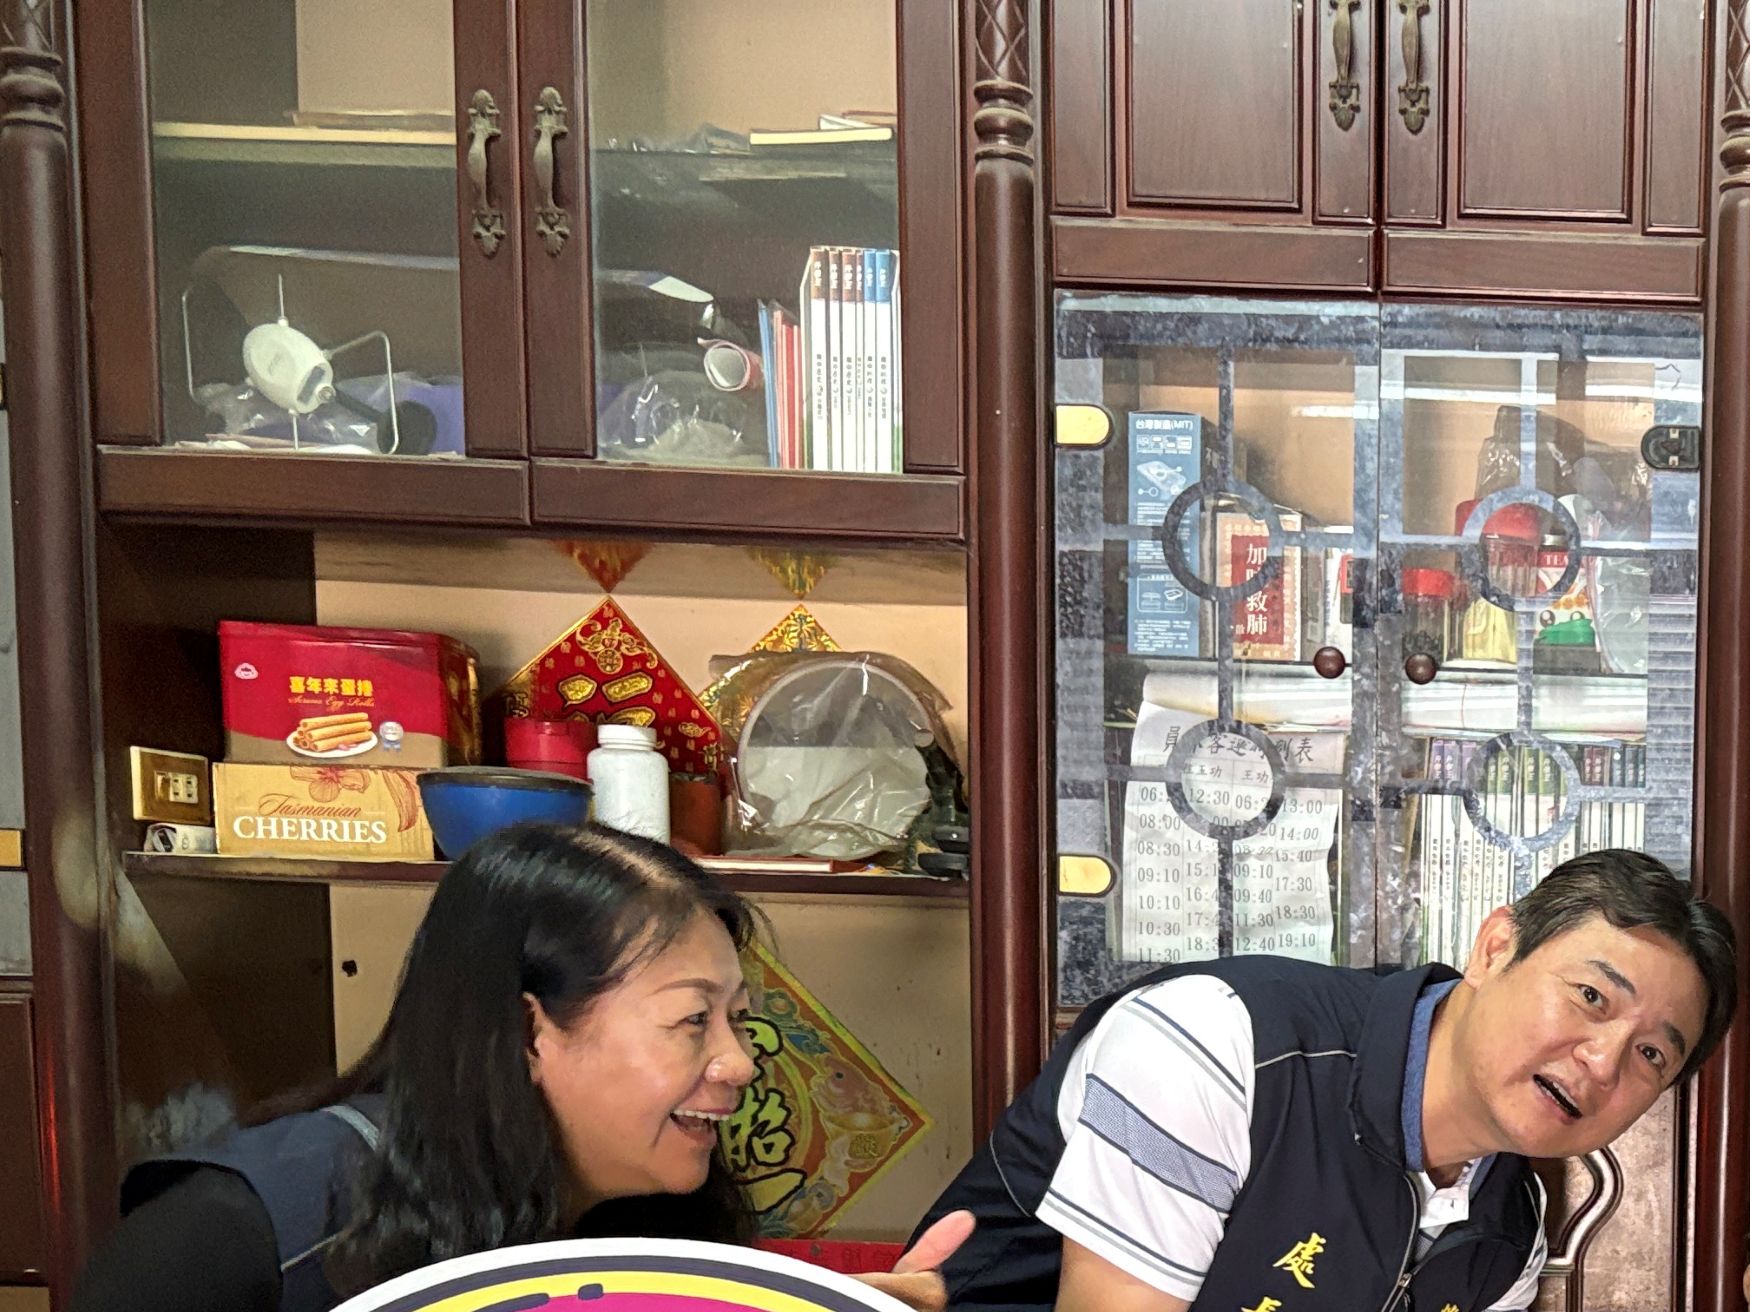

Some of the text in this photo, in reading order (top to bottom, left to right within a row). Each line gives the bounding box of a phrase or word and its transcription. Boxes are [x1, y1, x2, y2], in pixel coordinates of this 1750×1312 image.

[258, 793, 362, 818] Tasmanian
[1190, 788, 1230, 805] 12:30
[1283, 800, 1322, 814] 13:00
[233, 815, 387, 844] CHERRIES
[1139, 814, 1319, 841] 08:00 14:00
[1137, 840, 1180, 856] 08:30
[1138, 863, 1312, 892] 09:10 15:1 09:10 17:30
[1139, 888, 1315, 919] 10:10 16:4 09:40 18:30
[1138, 922, 1180, 936] 10:30
[1235, 914, 1274, 927] 11:30
[1279, 933, 1316, 948] 19:10
[1139, 937, 1274, 963] 11:30 18:3 12:40
